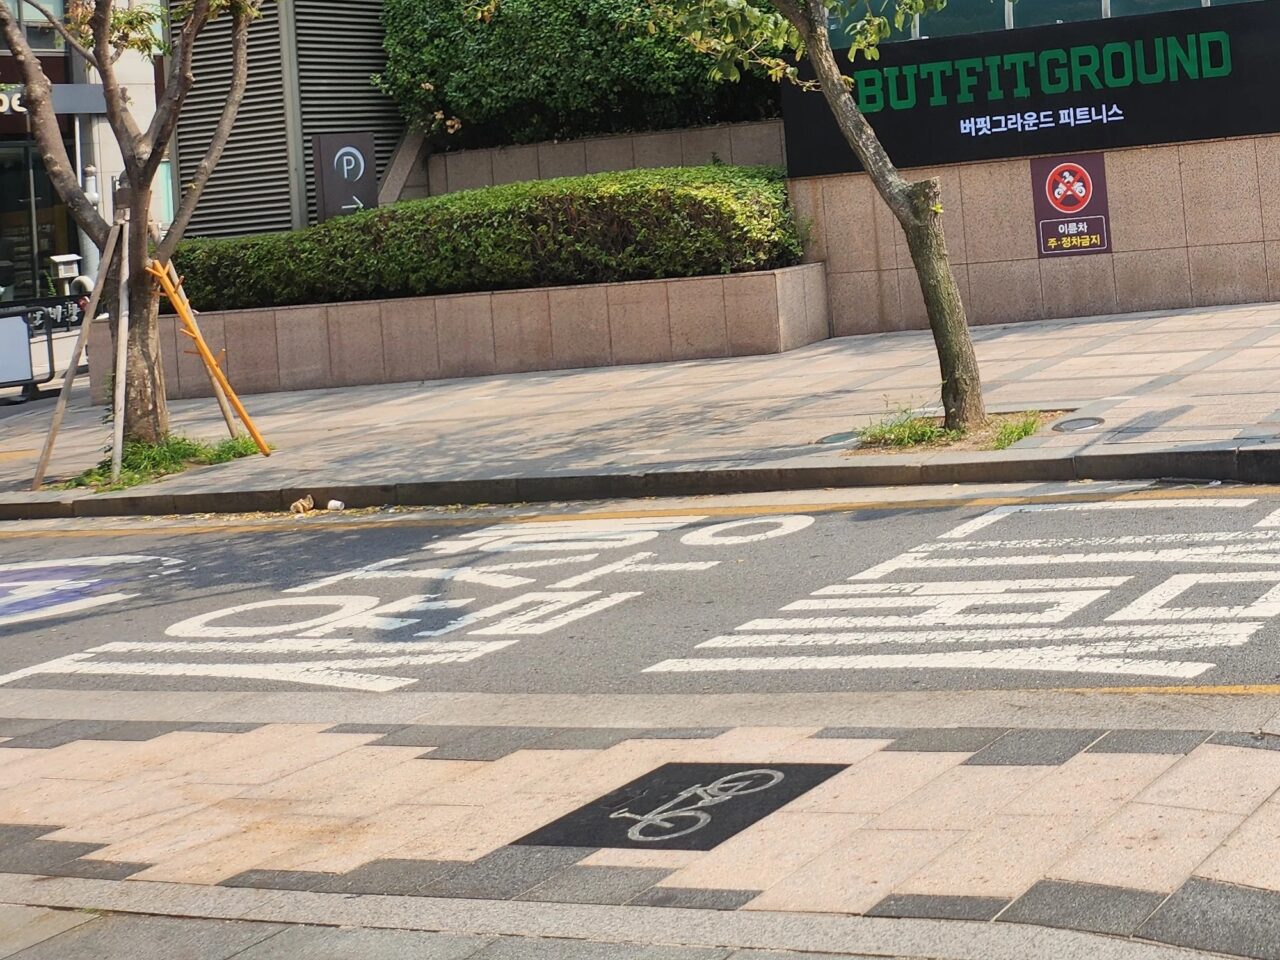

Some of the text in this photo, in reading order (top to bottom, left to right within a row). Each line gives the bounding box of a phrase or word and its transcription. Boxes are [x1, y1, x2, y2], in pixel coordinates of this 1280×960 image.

[852, 31, 1232, 114] BUTFITGROUND
[960, 103, 1125, 137] 버핏그라운드 피트니스
[343, 155, 355, 179] P
[1058, 222, 1088, 234] 이륜차
[1047, 234, 1101, 248] 주·정차금지
